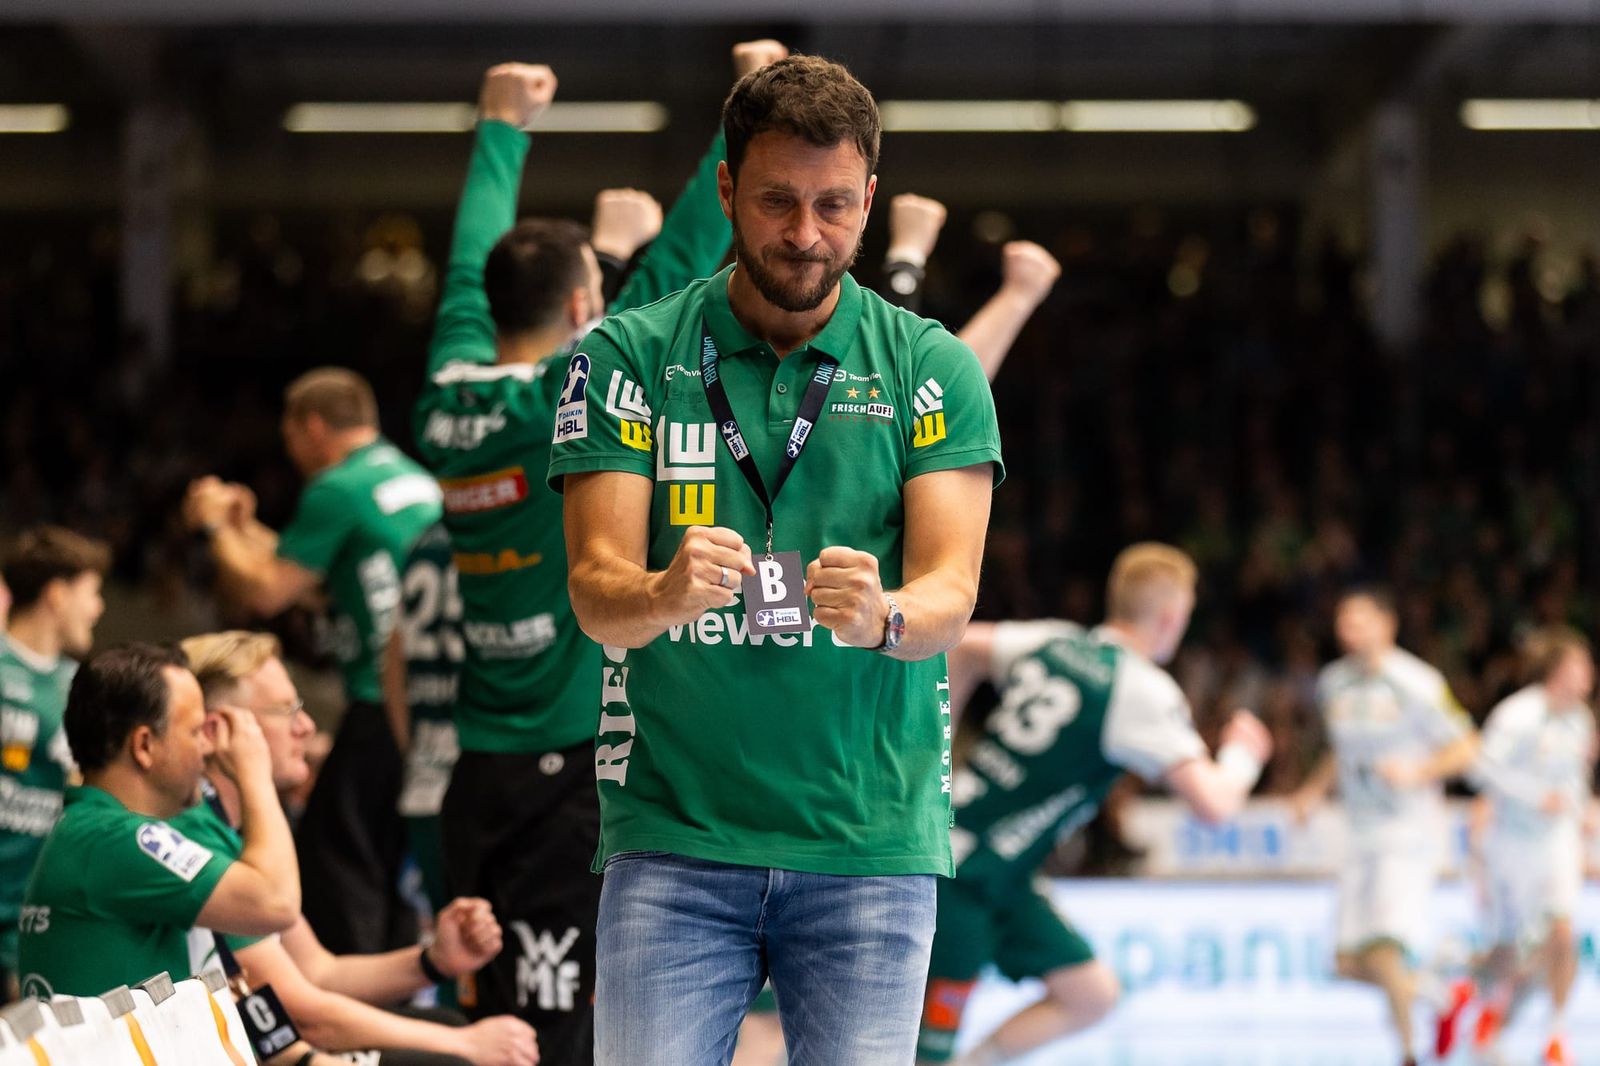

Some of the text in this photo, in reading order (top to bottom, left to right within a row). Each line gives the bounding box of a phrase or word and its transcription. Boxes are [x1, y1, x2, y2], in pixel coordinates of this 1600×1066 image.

[703, 363, 718, 388] HBL
[562, 409, 583, 419] DAIKIN
[831, 403, 892, 416] FRISCH AUF!
[557, 420, 584, 437] HBL
[796, 423, 810, 442] HBL
[729, 438, 742, 458] HBL
[758, 561, 788, 603] B
